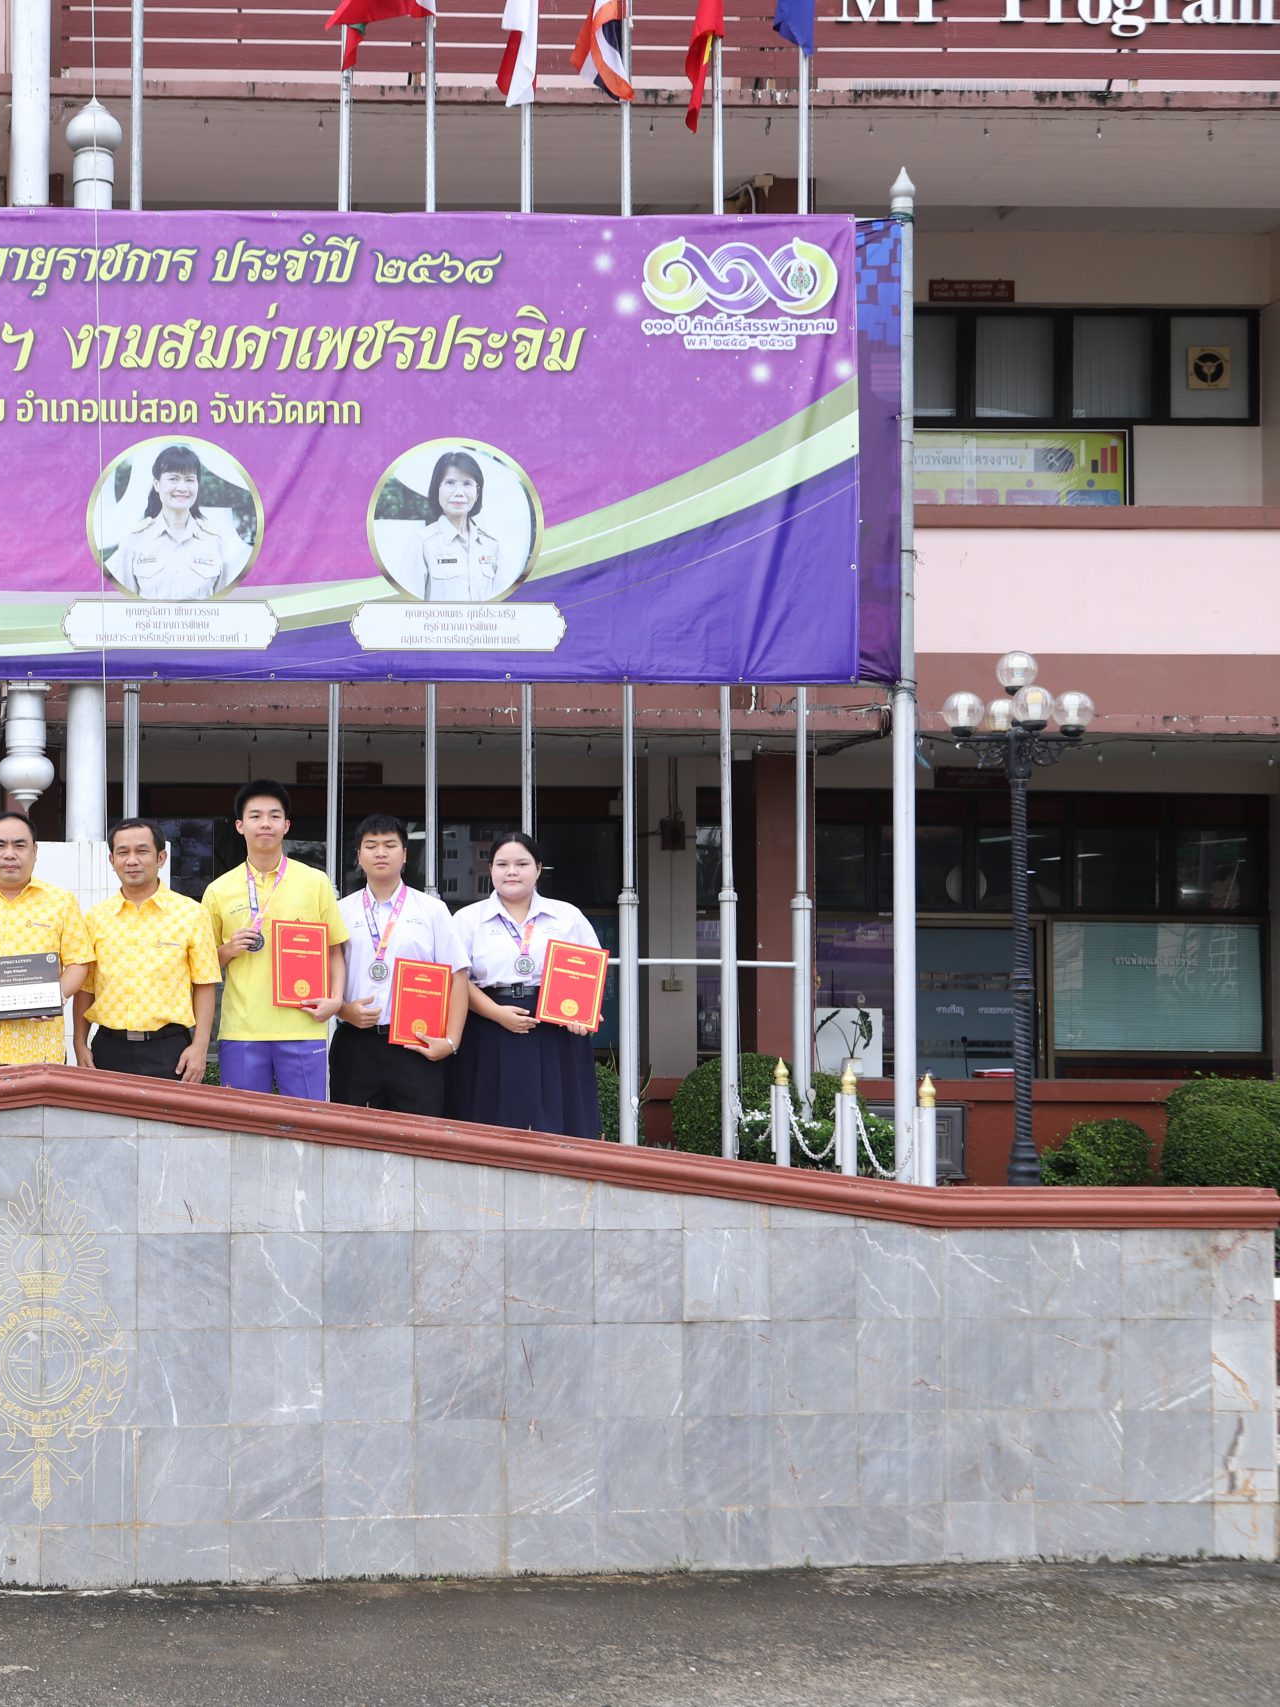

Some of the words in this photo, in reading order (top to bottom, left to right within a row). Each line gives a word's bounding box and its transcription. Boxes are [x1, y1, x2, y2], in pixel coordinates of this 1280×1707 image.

[211, 233, 361, 284] ประจำปี
[374, 250, 503, 284] ๒๕๖๘
[63, 303, 587, 372] งามสมค่าเพชรประจิม
[677, 319, 689, 332] ปี
[693, 315, 835, 334] ศักดิ์ศรีสรรพวิทยาคม
[686, 337, 710, 347] พ.ศ.
[16, 390, 199, 424] อำเภอแม่สอด
[210, 391, 362, 424] จังหวัดตาก
